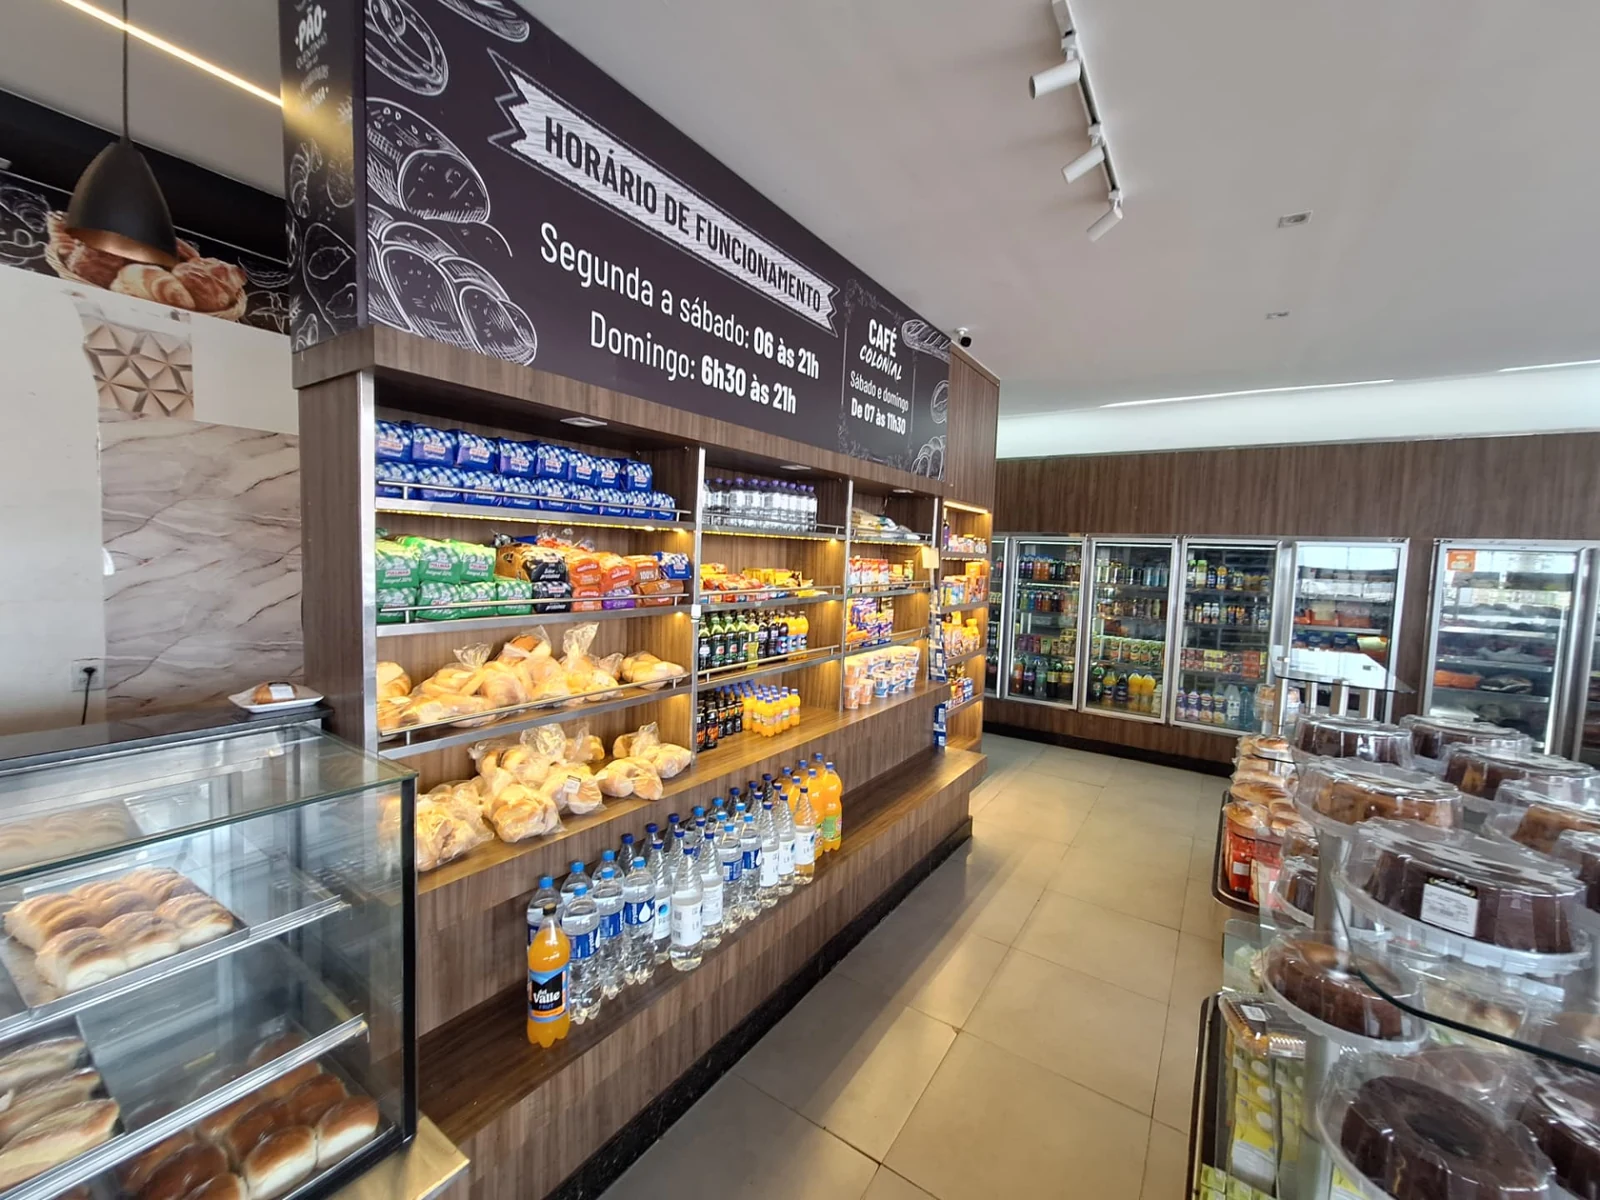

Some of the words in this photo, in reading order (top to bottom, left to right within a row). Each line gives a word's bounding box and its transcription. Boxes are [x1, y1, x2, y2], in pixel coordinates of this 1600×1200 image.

[298, 4, 322, 52] PÃO
[545, 115, 657, 214] HORÁRIO
[664, 193, 690, 235] DE
[696, 213, 821, 313] FUNCIONAMENTO
[540, 222, 653, 307] Segunda
[661, 289, 673, 316] a
[679, 296, 749, 349] sábado:
[753, 326, 774, 360] 06
[777, 337, 795, 369] às
[797, 347, 820, 380] 21h
[868, 318, 897, 358] CAFÉ
[590, 310, 696, 382] Domingo:
[701, 354, 746, 397] 6h30
[750, 373, 769, 403] às
[773, 382, 797, 415] 21h
[859, 344, 903, 382] COLONIAL
[850, 370, 876, 396] Sábado
[877, 388, 882, 400] e
[883, 387, 909, 414] domingo
[851, 397, 863, 419] De
[864, 403, 875, 423] 07
[876, 408, 886, 428] às
[887, 412, 907, 436] 11h30
[533, 990, 561, 1004] Valle
